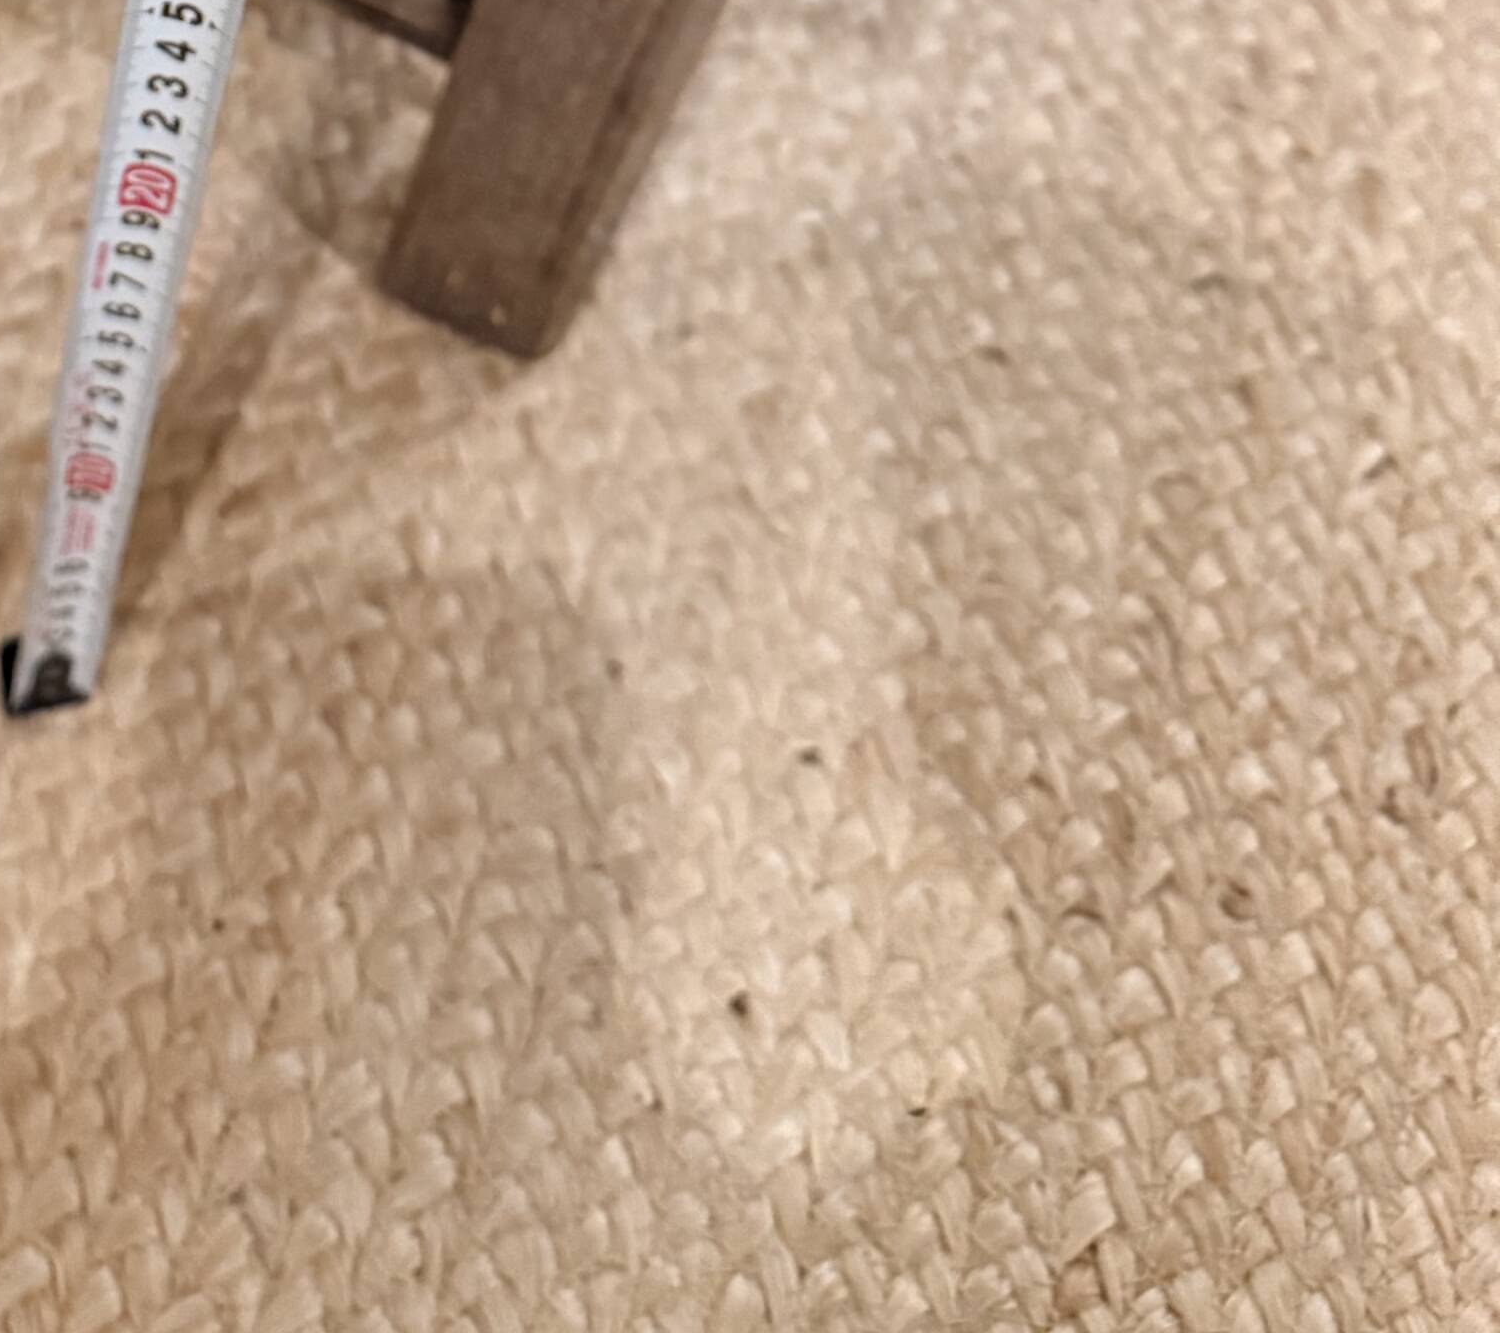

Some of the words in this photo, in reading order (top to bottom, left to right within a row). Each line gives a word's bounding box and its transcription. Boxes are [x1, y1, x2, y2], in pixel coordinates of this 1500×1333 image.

[161, 2, 203, 26] 5
[155, 41, 196, 63] 4
[147, 75, 189, 99] 3
[140, 110, 181, 135] 2
[122, 168, 174, 213] 20
[121, 210, 160, 231] 9
[114, 242, 154, 263] 8
[108, 271, 146, 291] 7
[102, 302, 141, 322] 6
[96, 331, 135, 351] 5
